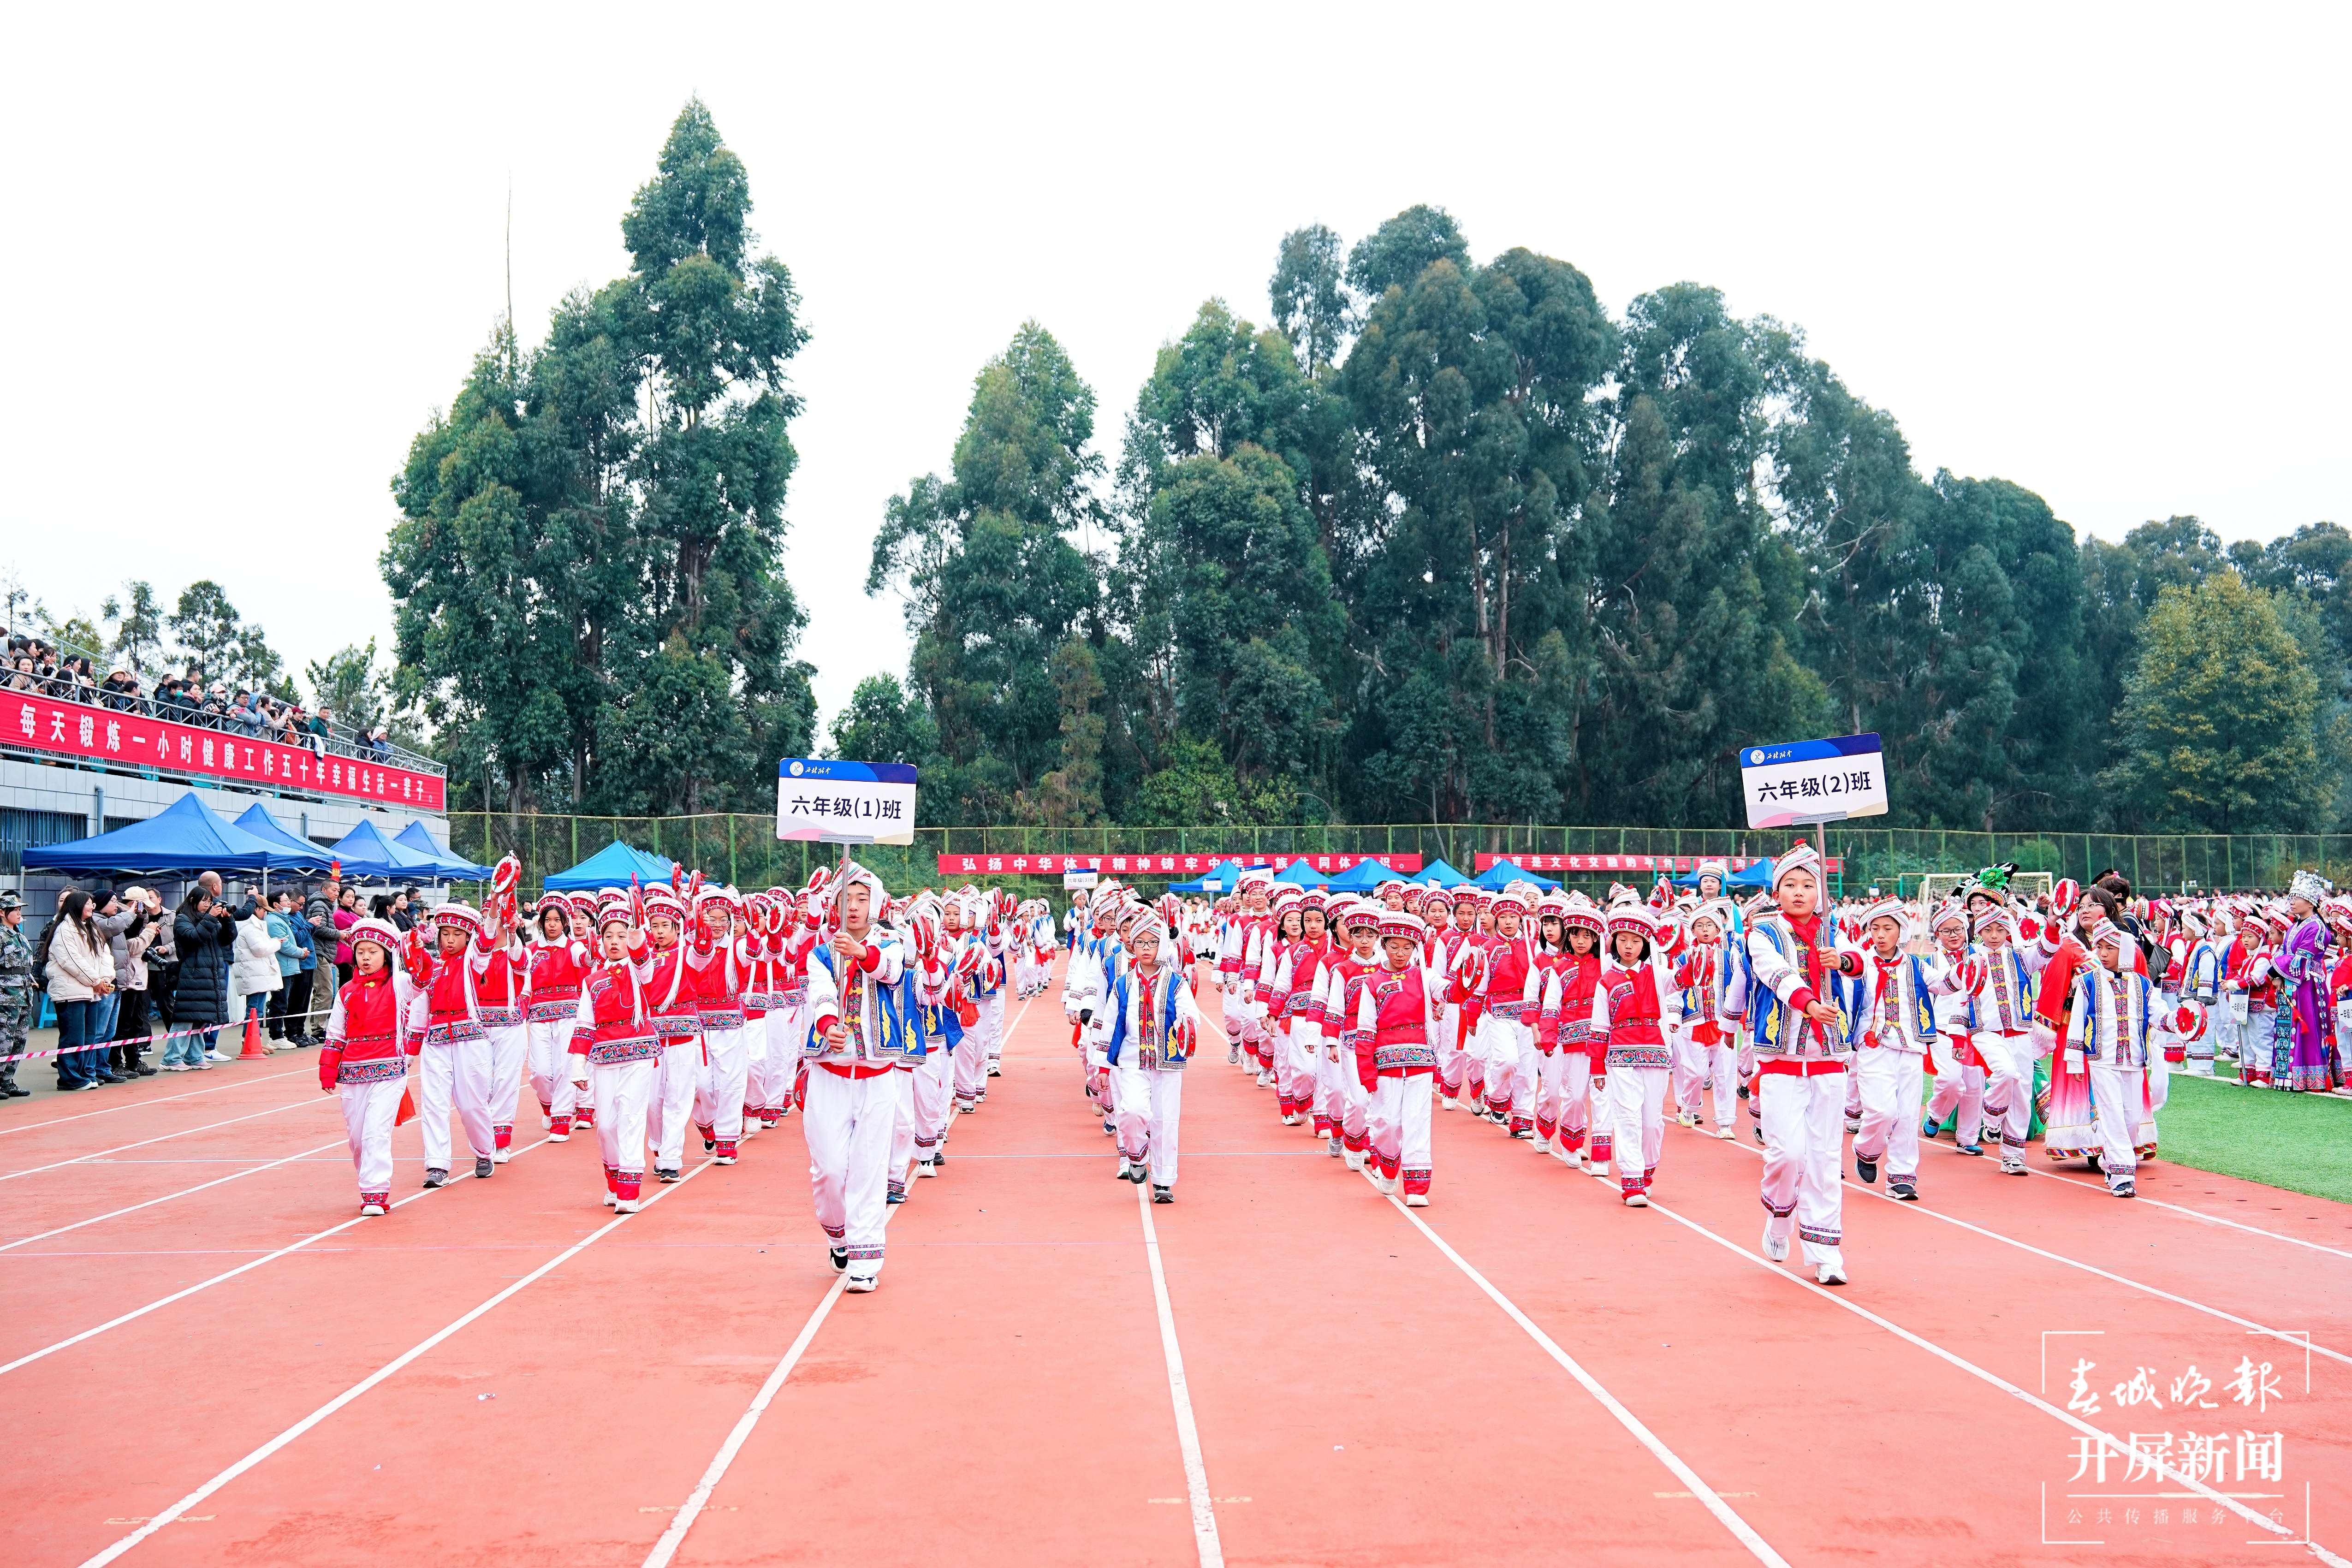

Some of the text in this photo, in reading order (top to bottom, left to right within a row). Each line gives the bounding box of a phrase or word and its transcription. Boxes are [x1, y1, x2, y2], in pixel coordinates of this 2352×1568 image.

[20, 702, 433, 803] 每天锻炼一小时健康工作五十年幸福生活一辈子。
[1758, 771, 1871, 802] 六年级(2)班
[791, 796, 902, 819] 六年级(1)班
[962, 856, 1404, 871] 弘扬中华体育精神铸牢中华民族同体识。
[2340, 1008, 2352, 1019] 一年级(
